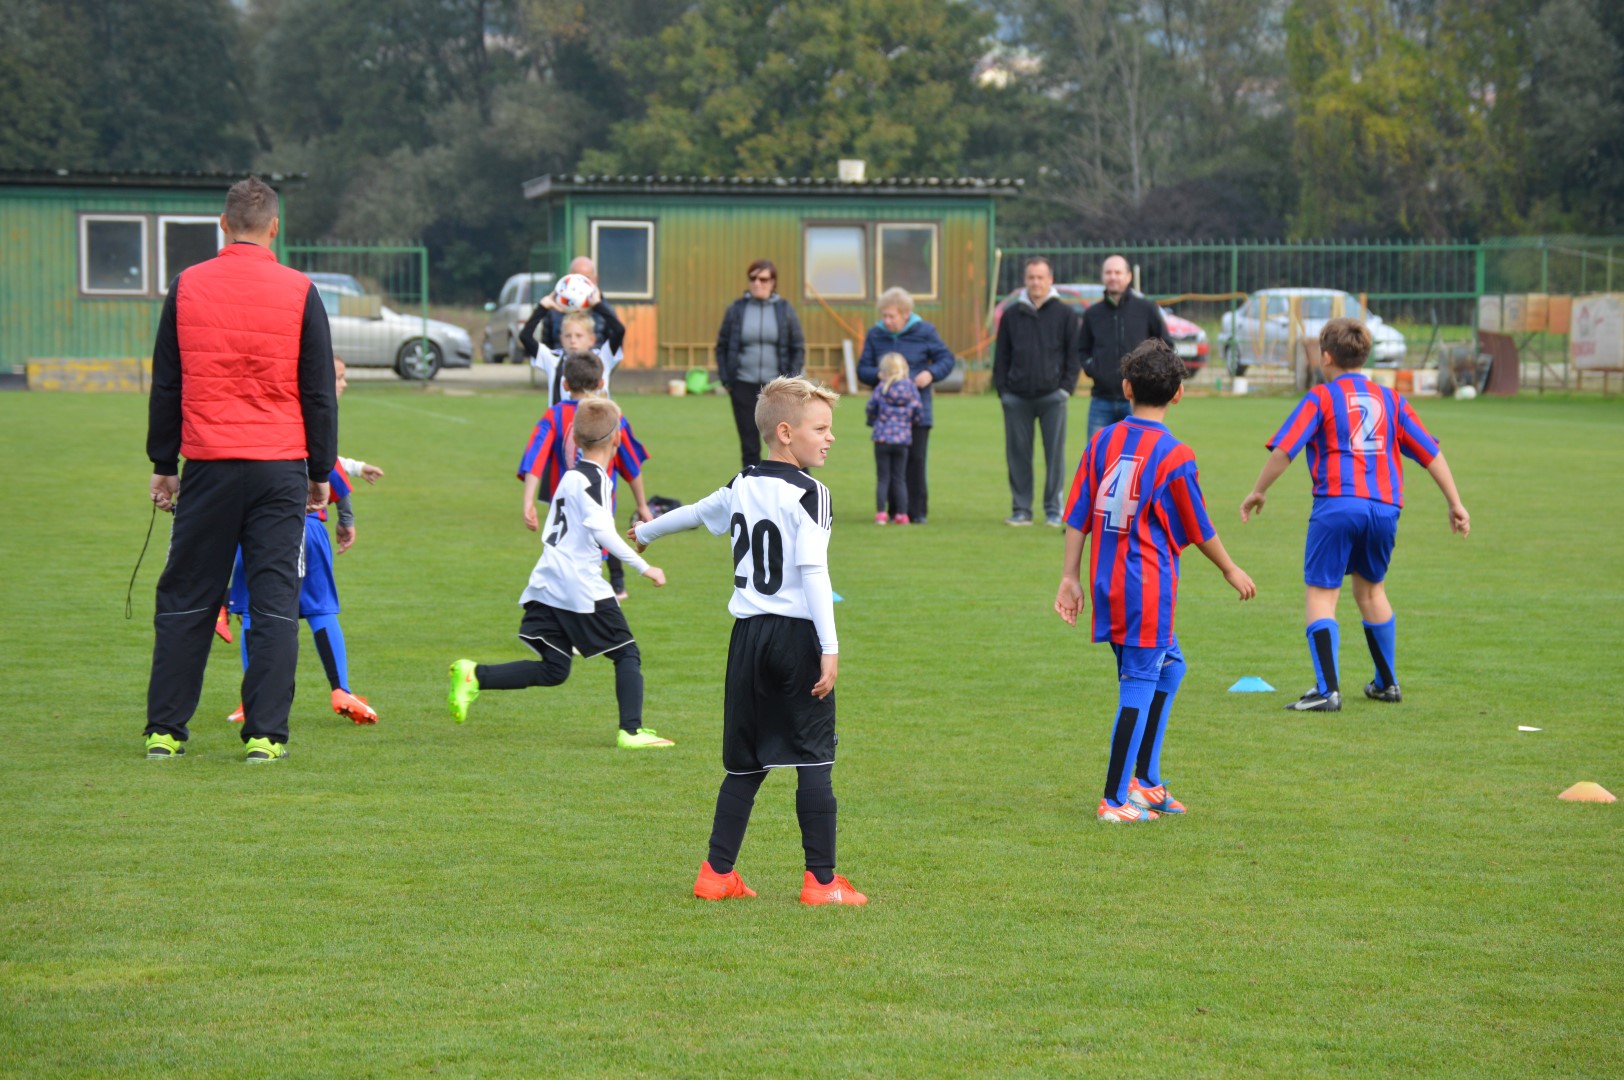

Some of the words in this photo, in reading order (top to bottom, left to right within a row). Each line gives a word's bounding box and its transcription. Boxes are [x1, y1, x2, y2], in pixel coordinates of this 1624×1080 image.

[1346, 392, 1386, 455] 2
[545, 497, 569, 547] 5
[1094, 454, 1144, 533] 4
[731, 512, 783, 595] 20
